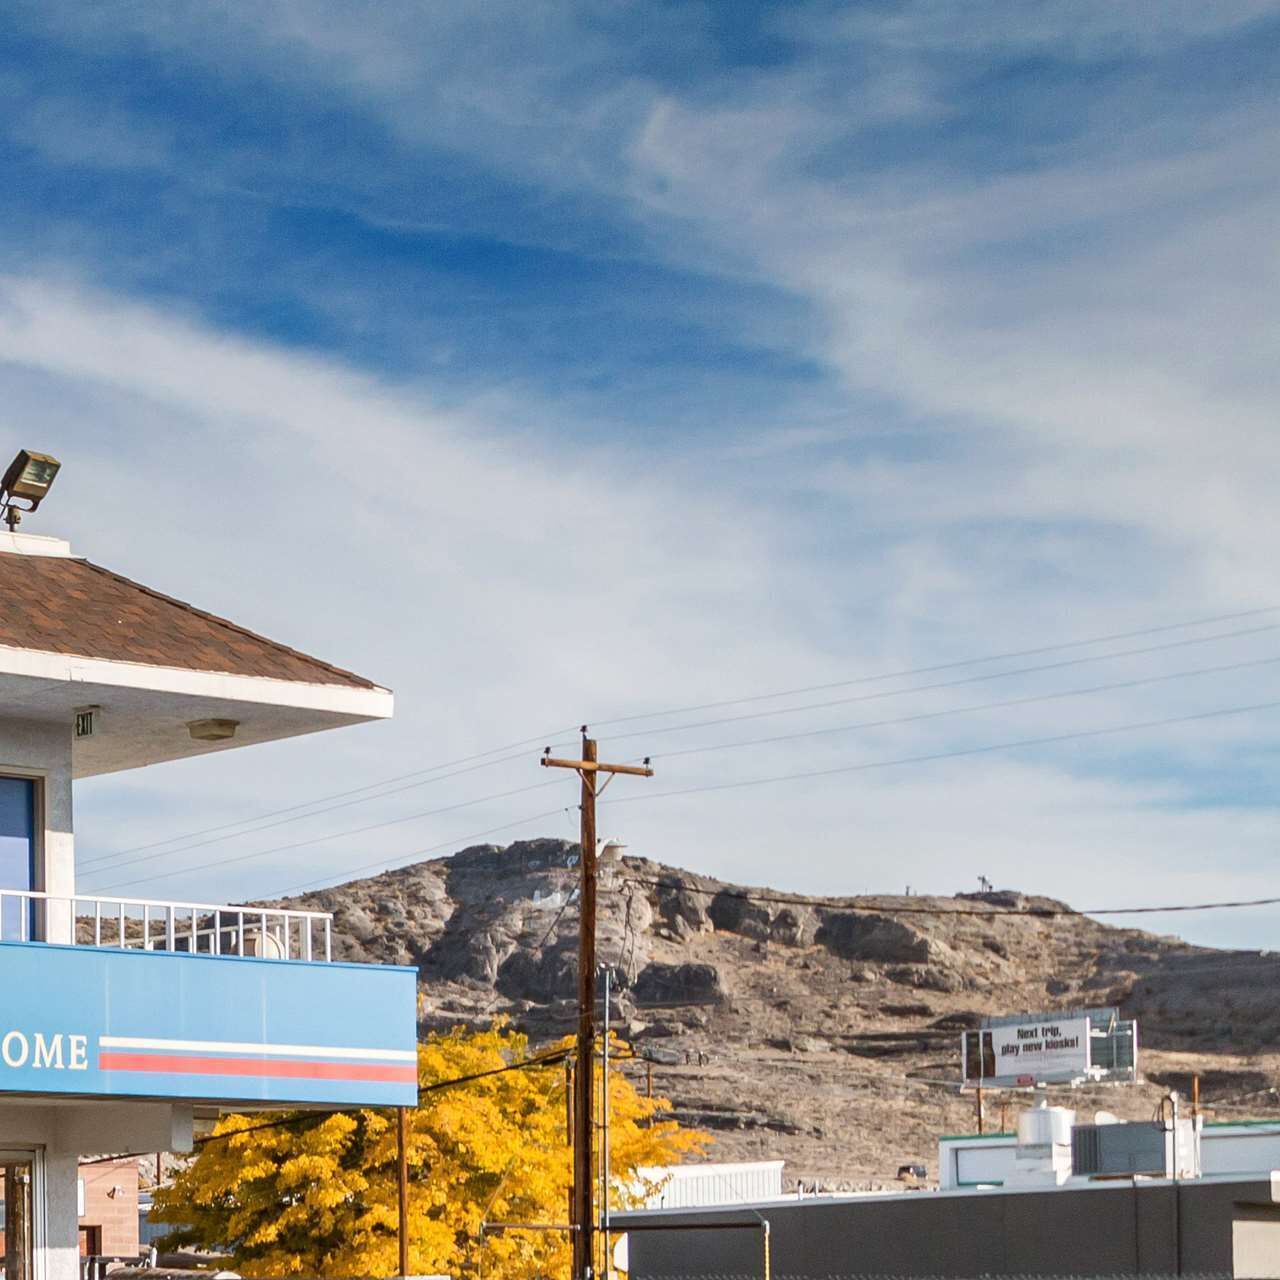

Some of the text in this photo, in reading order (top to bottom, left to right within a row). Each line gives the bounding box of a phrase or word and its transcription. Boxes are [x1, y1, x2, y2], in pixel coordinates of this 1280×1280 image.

[76, 712, 93, 737] EXIT
[1017, 1026, 1062, 1040] Next trip,
[1001, 1036, 1079, 1056] play new kiosks!
